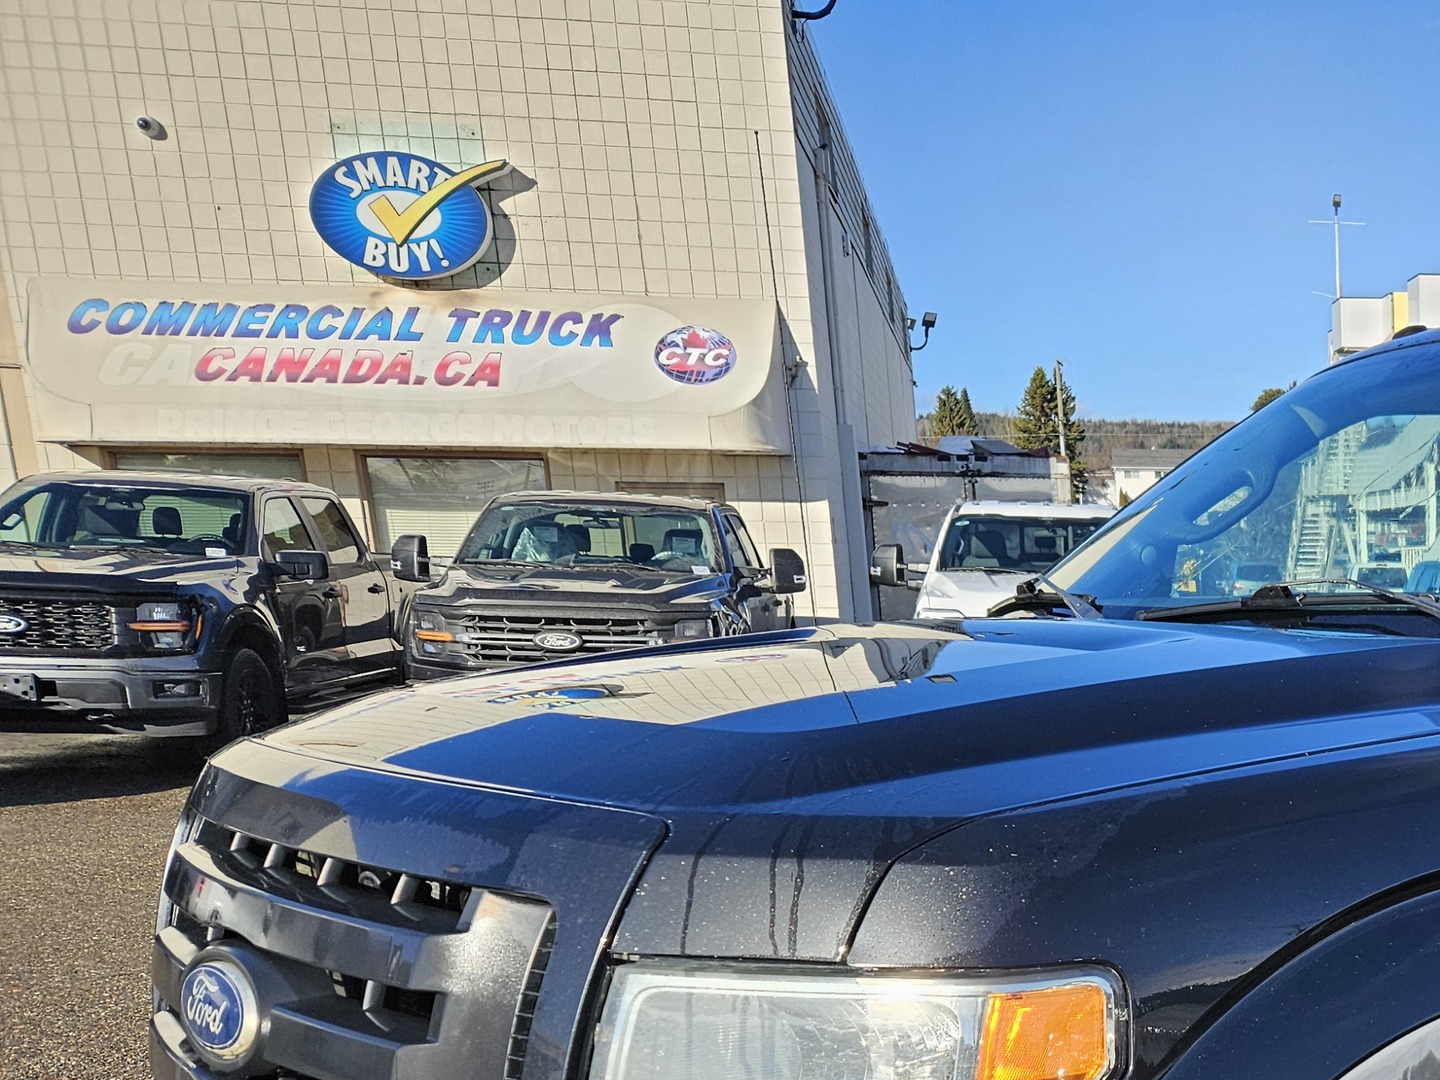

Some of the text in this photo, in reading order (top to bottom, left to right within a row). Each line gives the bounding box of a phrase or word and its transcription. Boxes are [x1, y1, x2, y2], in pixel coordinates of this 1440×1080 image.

[334, 156, 452, 198] SMART
[363, 236, 449, 273] BUY!
[67, 297, 624, 347] COMMERCIAL TRUCK
[194, 347, 502, 388] CANADA.CA
[658, 346, 730, 367] CTC
[186, 969, 228, 1036] Ford
